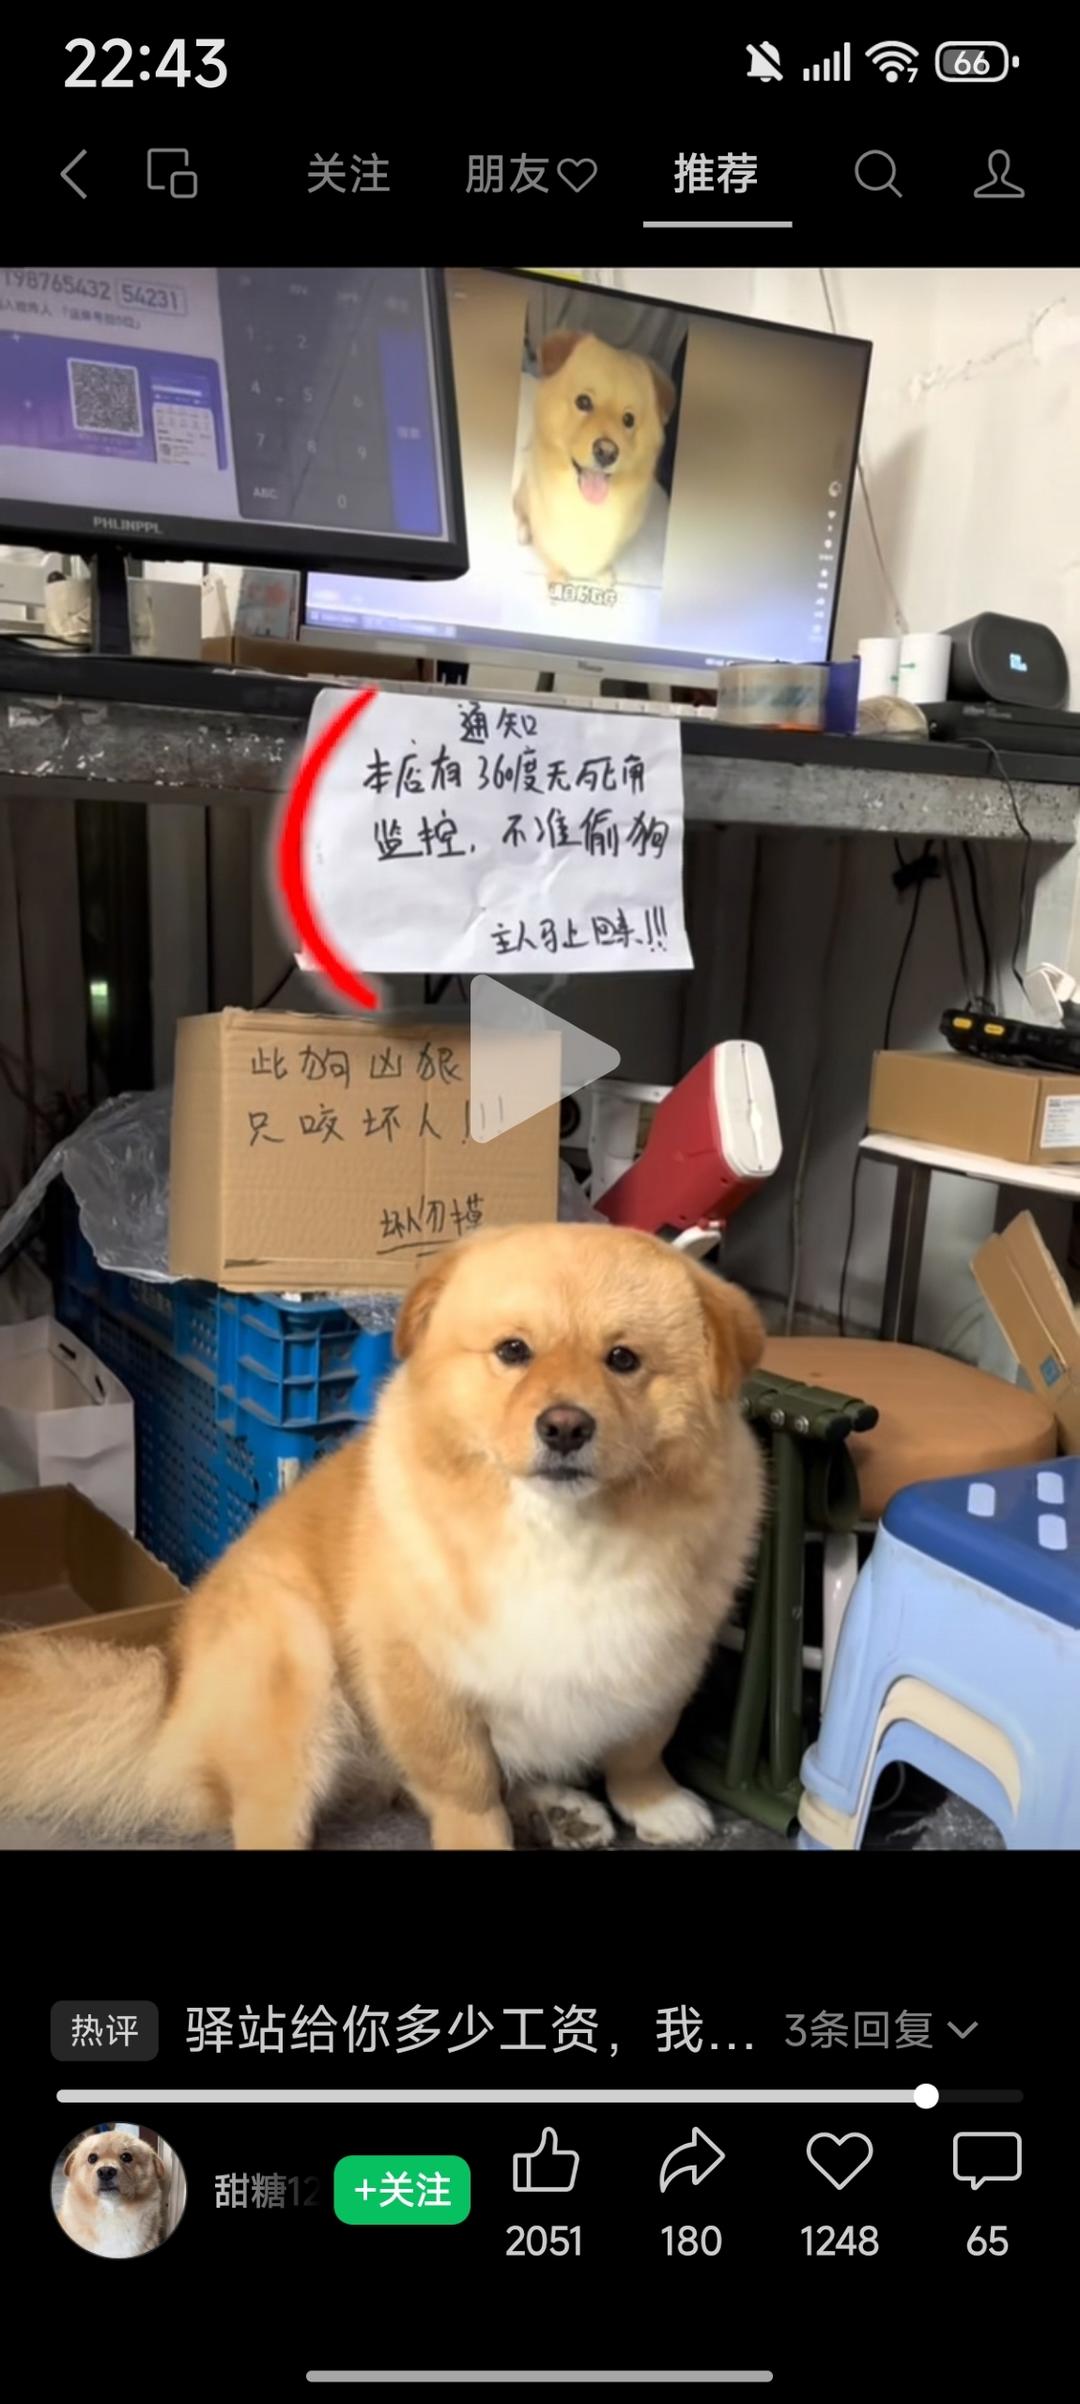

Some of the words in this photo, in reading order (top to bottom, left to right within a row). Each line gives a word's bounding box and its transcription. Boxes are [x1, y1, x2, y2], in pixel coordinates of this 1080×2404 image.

[122, 284, 178, 310] 54231
[296, 334, 309, 350] 2
[250, 379, 261, 395] 4
[302, 387, 312, 402] 5
[256, 433, 265, 448] 7
[357, 446, 367, 461] 9
[337, 494, 347, 509] 0
[458, 702, 539, 745] 通知
[362, 740, 646, 799] 本店有360度无死角
[251, 1042, 464, 1090] 此狗凶狠
[380, 1193, 485, 1238] 坏人勿摸
